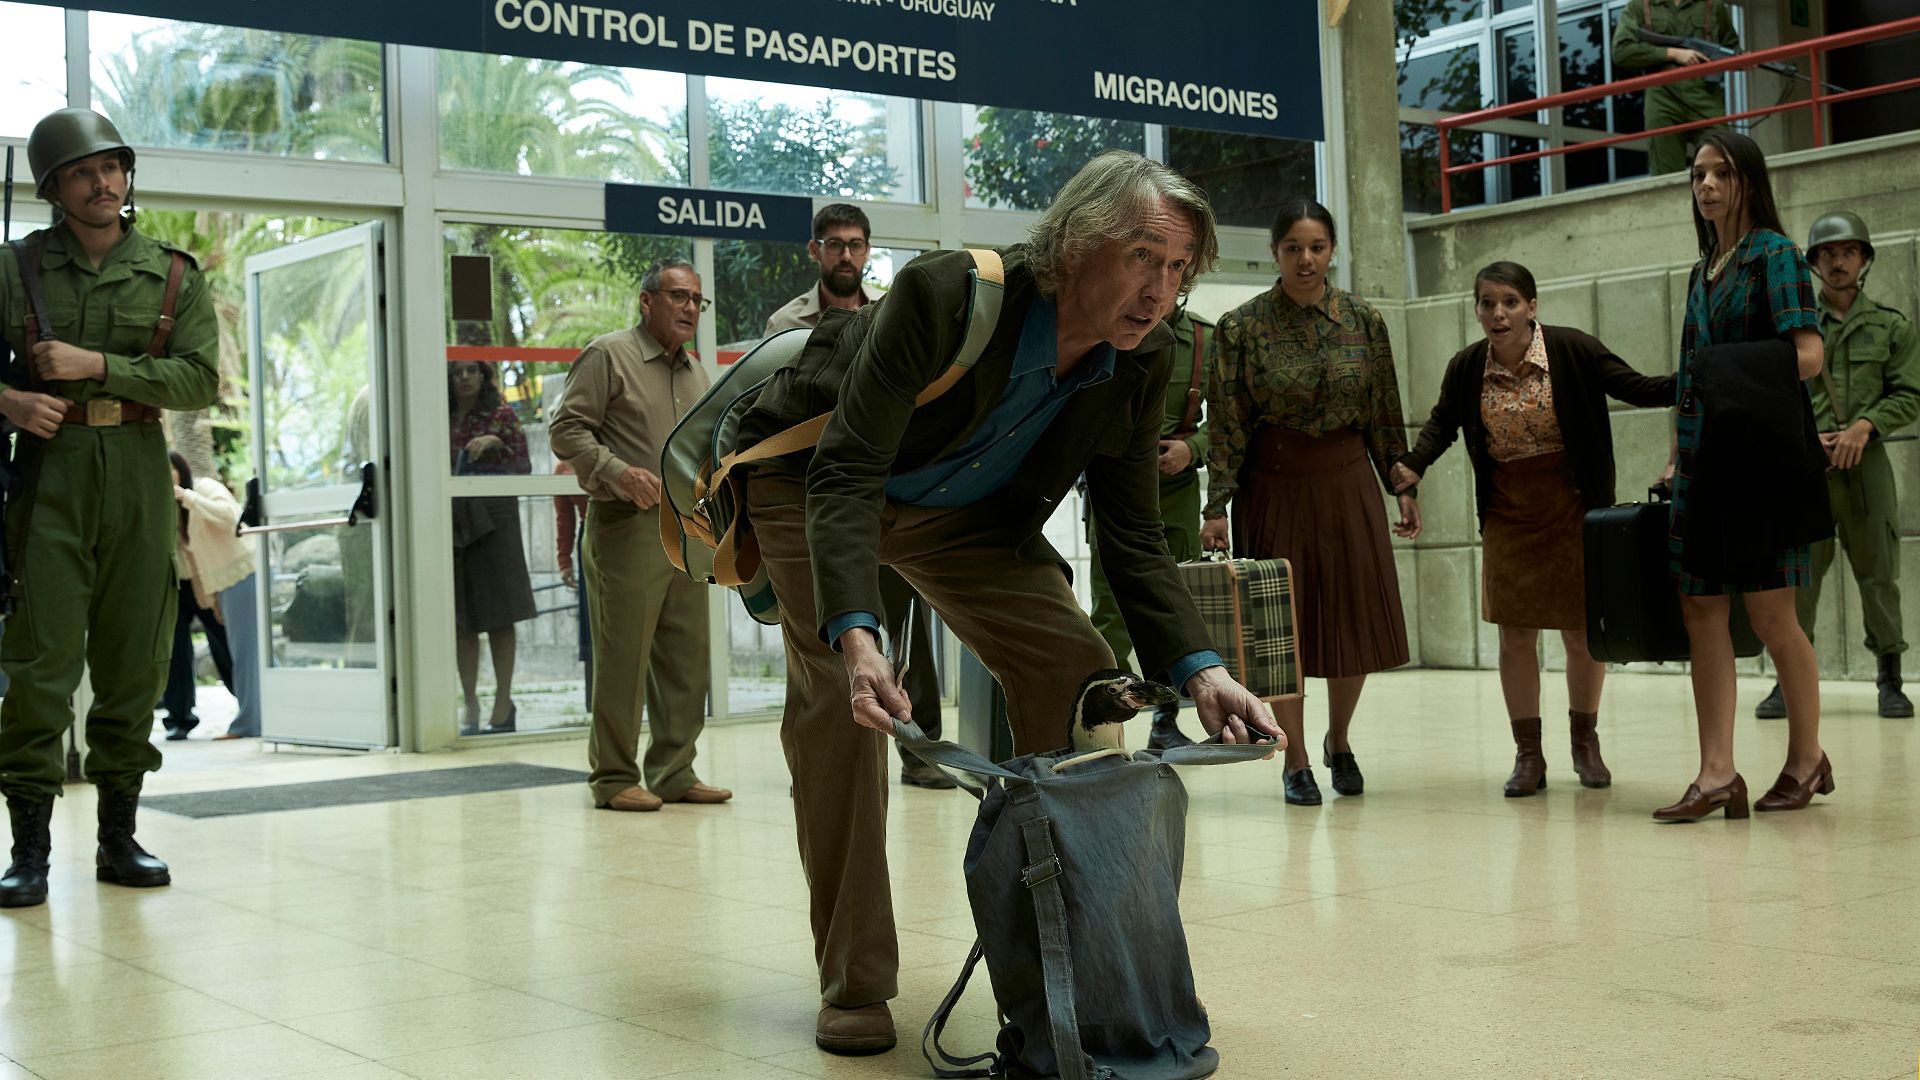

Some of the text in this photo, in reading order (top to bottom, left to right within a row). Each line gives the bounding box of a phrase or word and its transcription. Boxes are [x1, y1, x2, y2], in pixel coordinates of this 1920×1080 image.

[899, 0, 997, 22] URUGUAY
[494, 0, 958, 82] CONTROL DE PASAPORTES
[1094, 70, 1279, 120] MIGRACIONES
[657, 196, 767, 229] SALIDA
